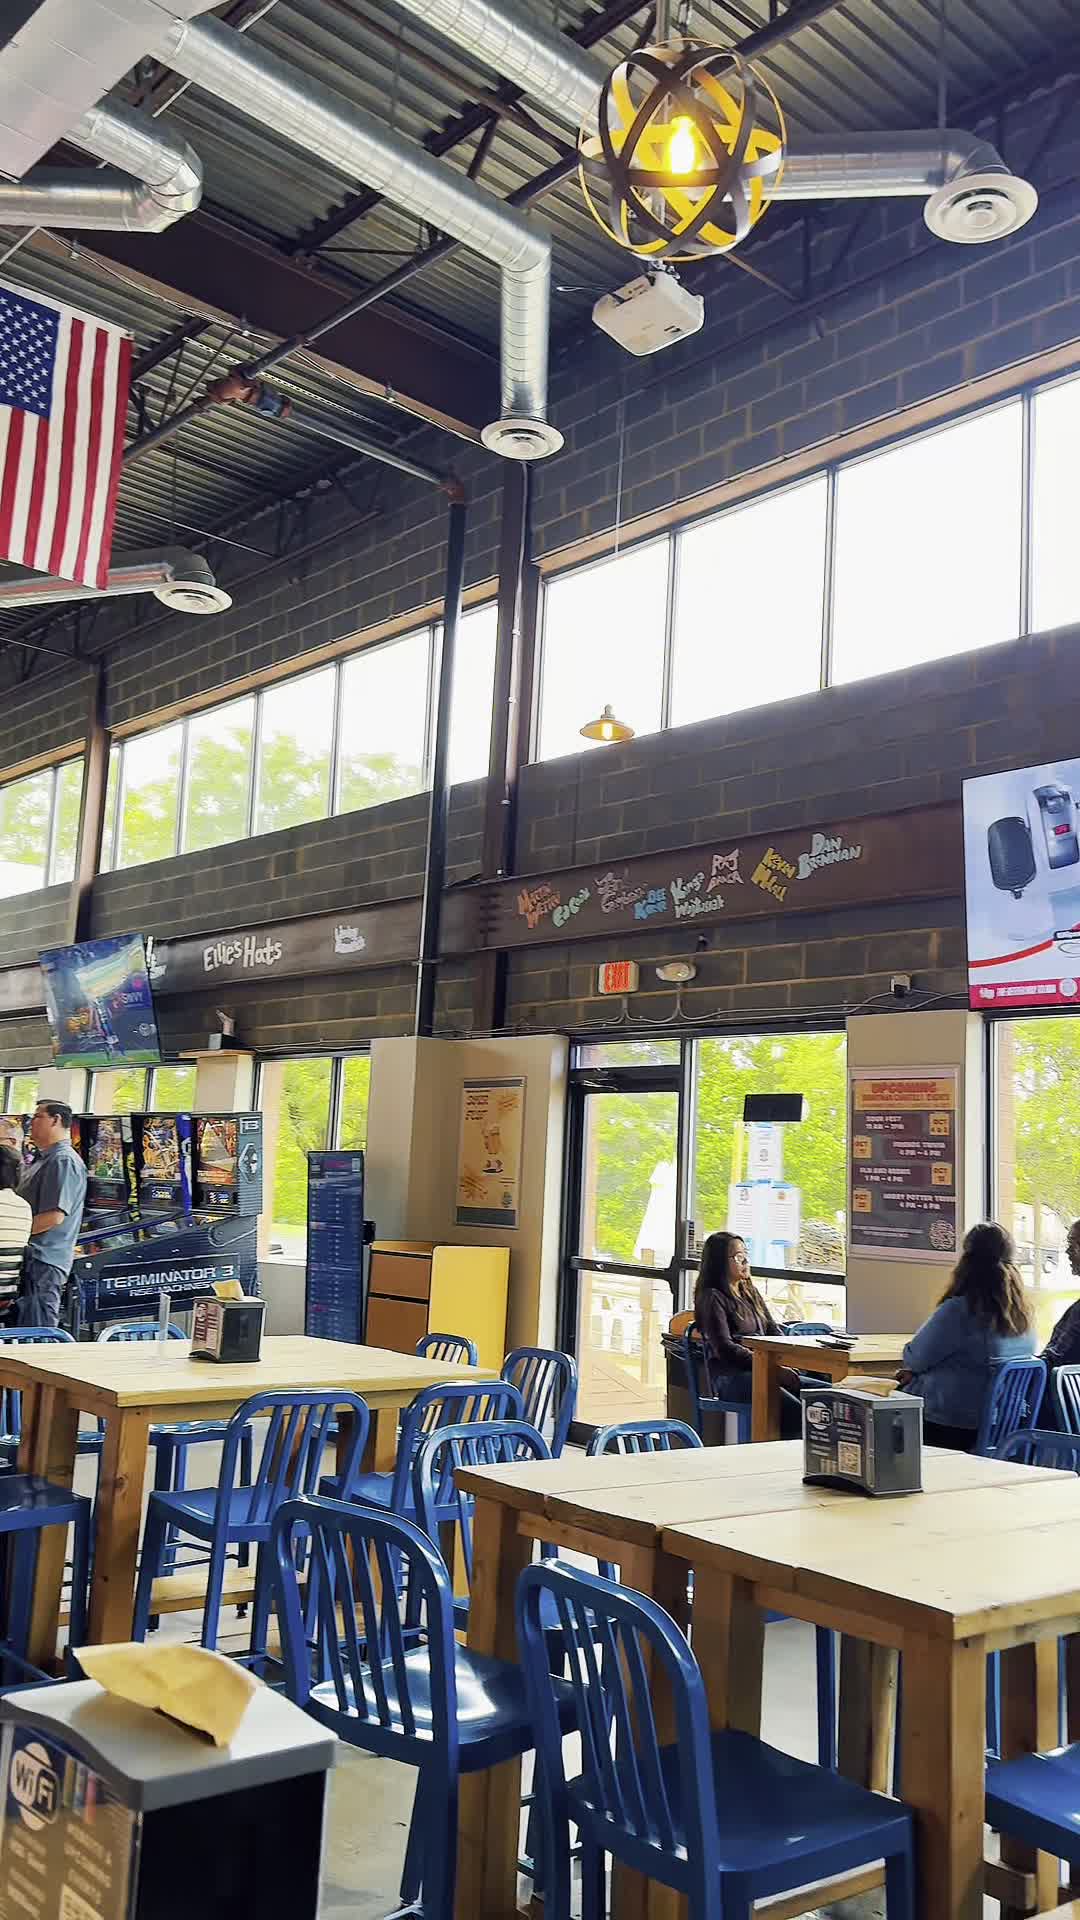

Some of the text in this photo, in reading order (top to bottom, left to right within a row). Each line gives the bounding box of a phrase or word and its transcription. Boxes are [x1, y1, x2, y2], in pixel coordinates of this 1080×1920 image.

[812, 833, 842, 855] DAN
[242, 935, 283, 968] Hats
[603, 961, 632, 993] EXIT
[103, 1265, 235, 1290] TERMINATOR 3
